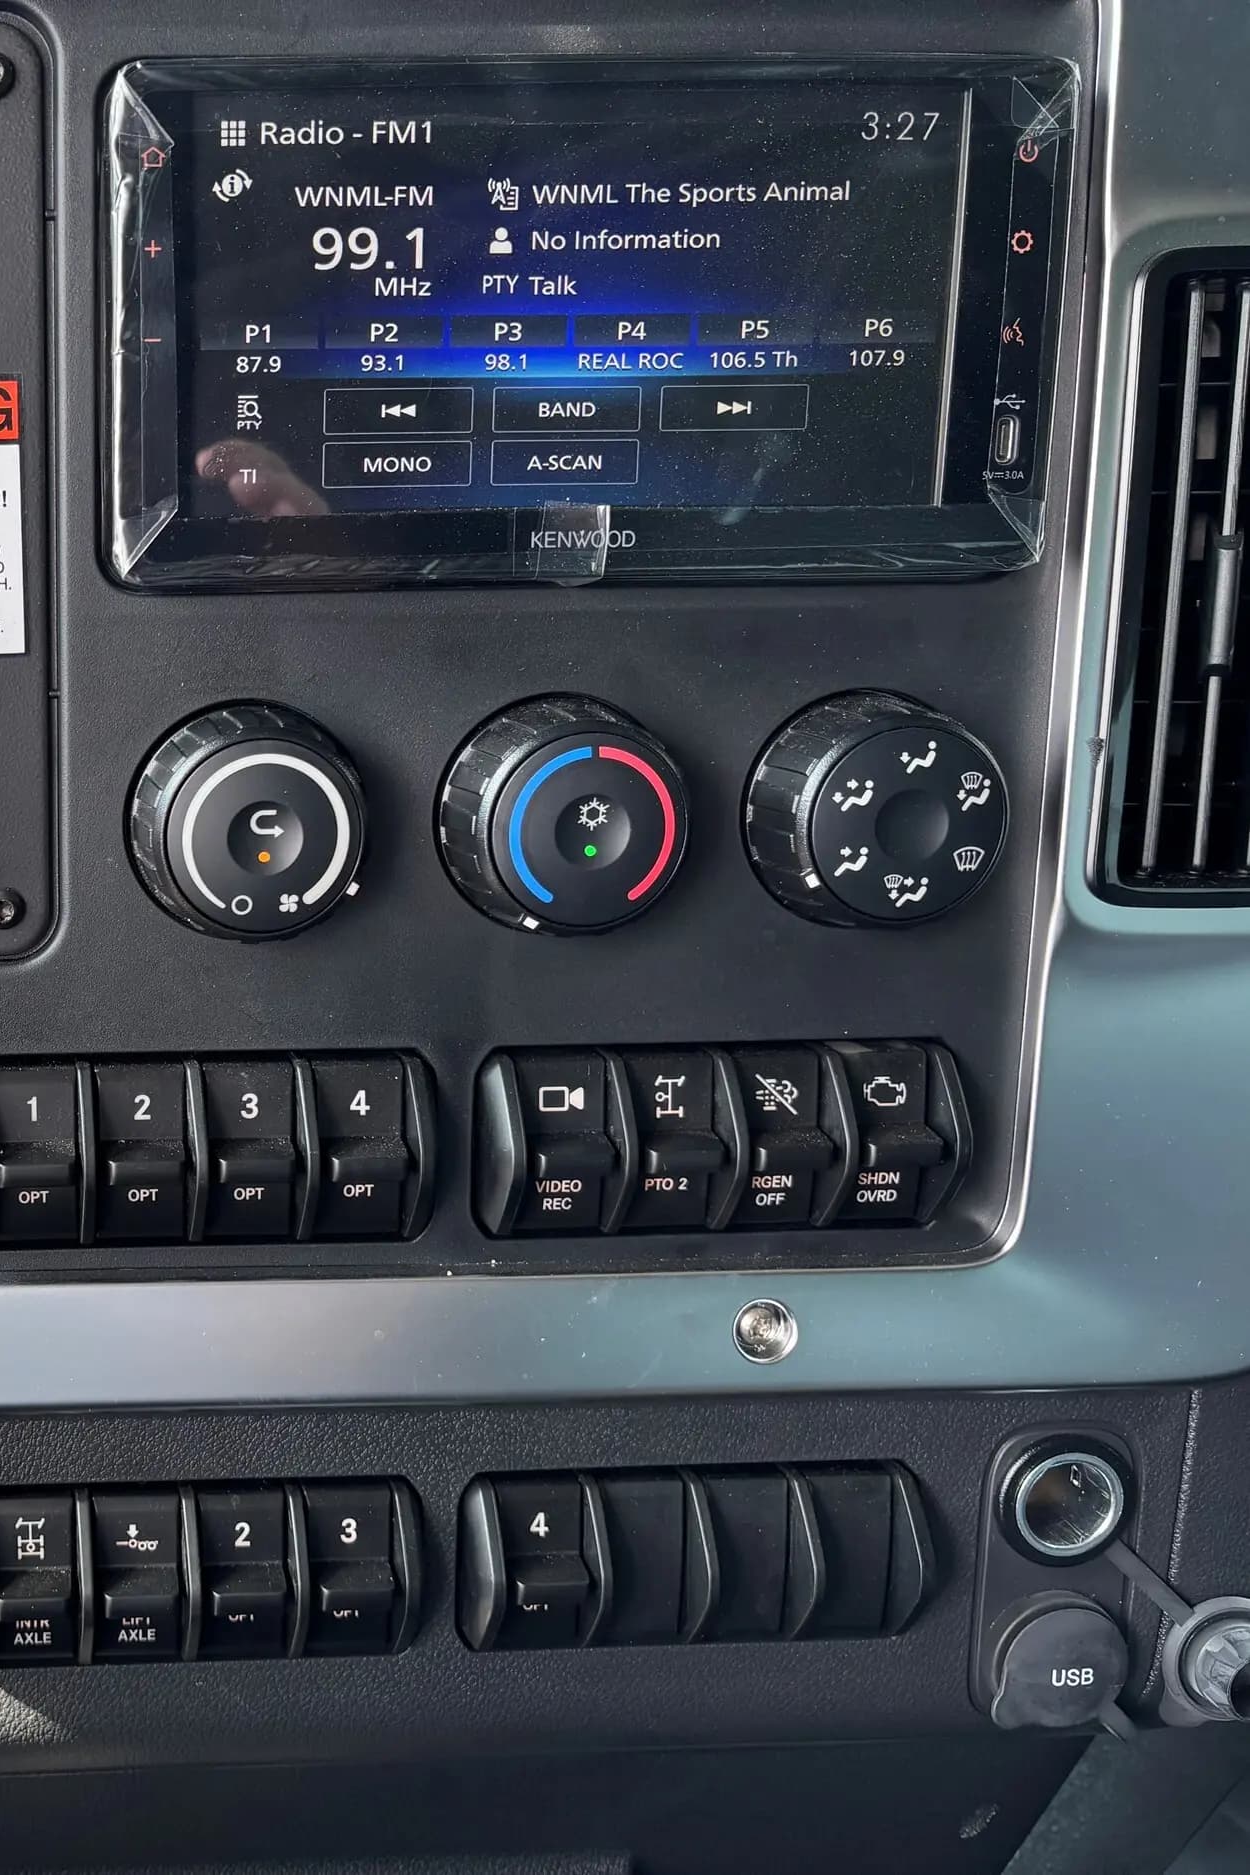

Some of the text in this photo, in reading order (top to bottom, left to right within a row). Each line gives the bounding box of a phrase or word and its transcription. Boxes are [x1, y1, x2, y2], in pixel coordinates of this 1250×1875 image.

[259, 120, 432, 145] Radio FM1
[860, 112, 940, 142] 3:27
[295, 185, 434, 208] WNML-FM
[532, 180, 851, 208] WNML The Sports Animal
[312, 227, 425, 271] 99.1
[531, 229, 721, 251] No Information
[374, 277, 432, 297] MHz
[482, 275, 577, 296] PTY Talk
[245, 324, 271, 344] P1
[370, 323, 398, 343] P2
[494, 322, 522, 342] P3
[617, 322, 647, 340] P4
[741, 320, 769, 339] P5
[864, 319, 894, 337] P6
[236, 356, 282, 373] 87.9
[360, 355, 404, 372] 93.1
[485, 354, 528, 370] 98.1
[578, 352, 685, 370] REAL ROC
[709, 351, 798, 368] 106.5 Th
[849, 350, 905, 367] 107.9
[538, 402, 597, 418] BAND
[237, 421, 262, 431] PTY
[362, 456, 432, 473] MONO
[527, 455, 603, 471] A-SCAN
[239, 469, 257, 484] TI
[530, 530, 636, 549] KENWOOD
[26, 1096, 38, 1122] 1
[134, 1095, 151, 1121] 2
[240, 1093, 259, 1119] 3
[349, 1090, 370, 1116] 4
[535, 1179, 582, 1194] VIDEO
[645, 1177, 688, 1192] PTO 2
[751, 1175, 792, 1190] RGEN
[857, 1172, 900, 1187] SHDN
[18, 1190, 49, 1204] OPT
[128, 1188, 158, 1203] OPT
[234, 1187, 265, 1201] OPT
[343, 1184, 375, 1198] OPT
[755, 1192, 785, 1207] OFF
[856, 1188, 898, 1203] OVRD
[542, 1197, 572, 1211] REC
[340, 1518, 357, 1544] 3
[530, 1512, 549, 1537] 4
[234, 1522, 251, 1548] 2
[14, 1631, 52, 1646] AXLE
[118, 1628, 156, 1643] AXLE
[1052, 1668, 1094, 1687] USB
